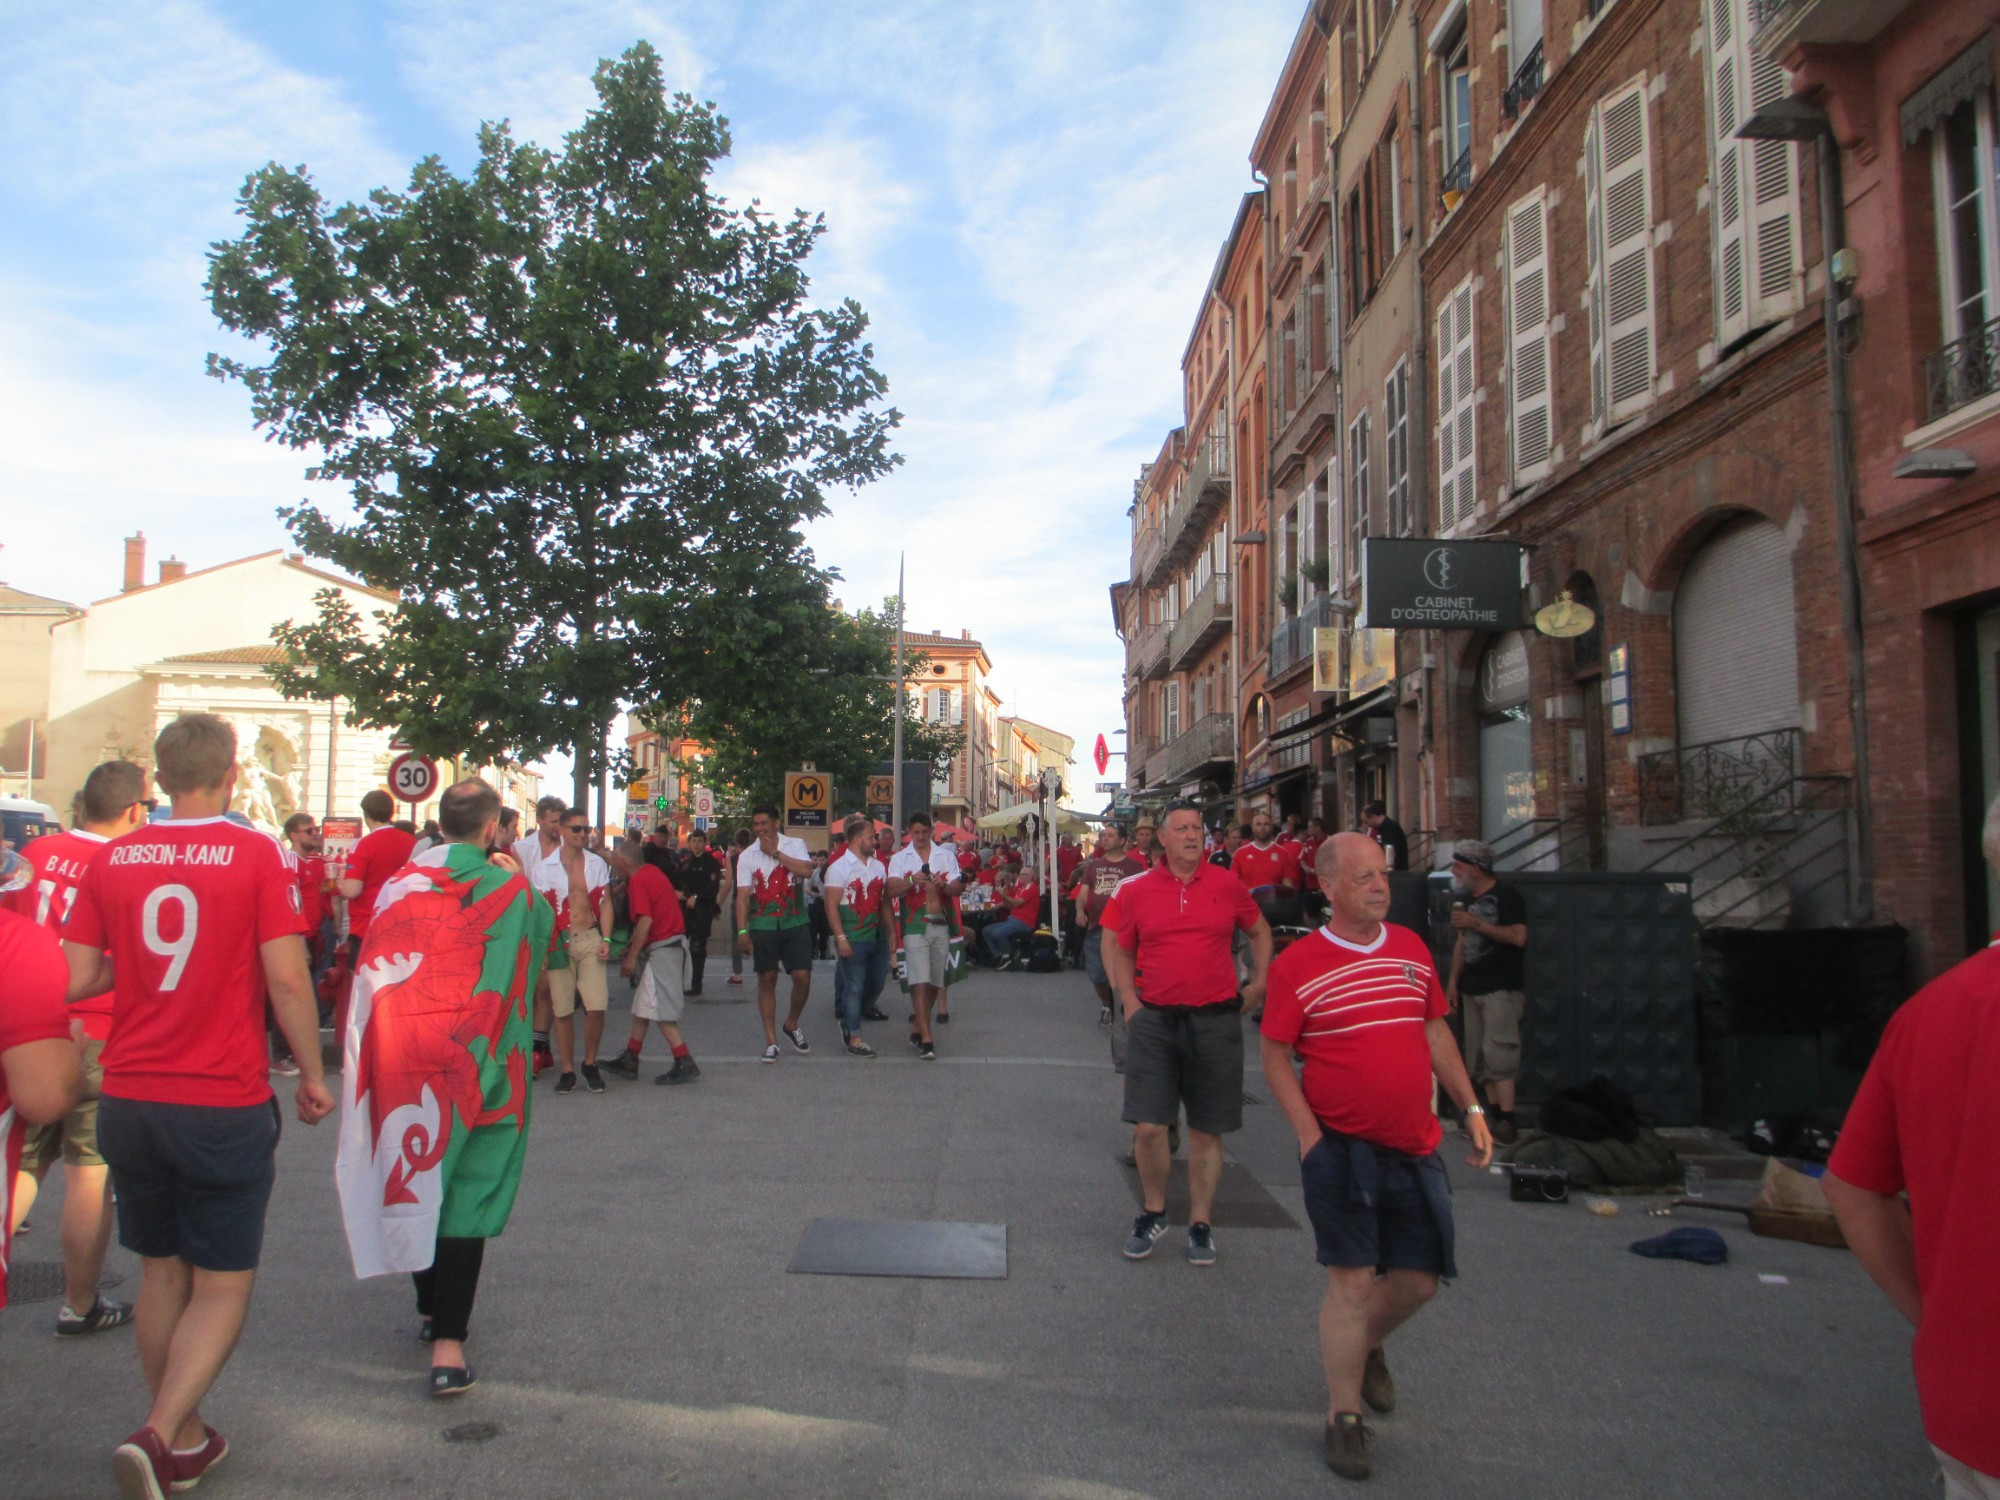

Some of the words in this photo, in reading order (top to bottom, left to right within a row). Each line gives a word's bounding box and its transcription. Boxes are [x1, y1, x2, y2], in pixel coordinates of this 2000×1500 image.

[1415, 596, 1474, 609] CABINET
[1391, 608, 1498, 622] D'OSTEOPATHIE
[399, 767, 427, 788] 30
[798, 783, 818, 801] M
[876, 784, 890, 798] M
[109, 844, 235, 866] ROBSON-KANU
[1108, 867, 1125, 875] REAL
[142, 883, 199, 992] 9
